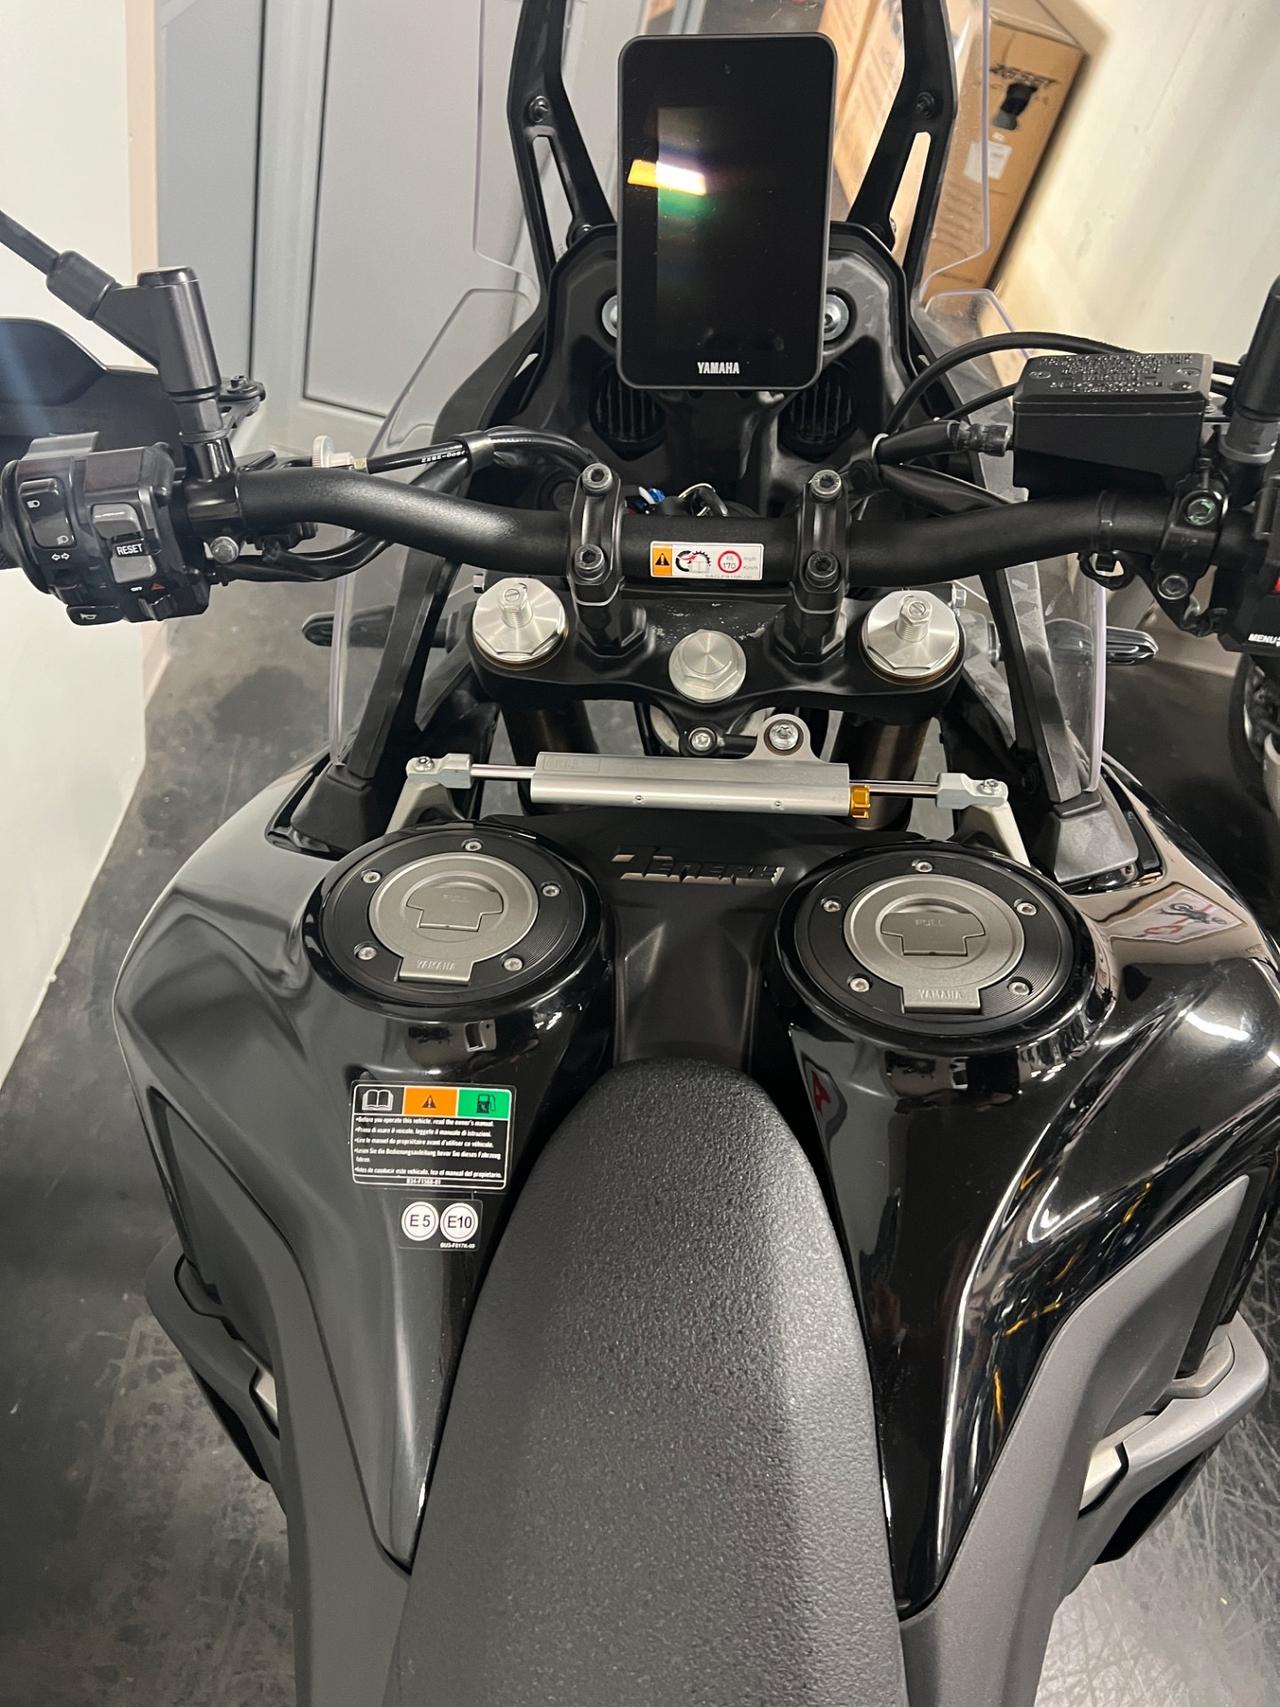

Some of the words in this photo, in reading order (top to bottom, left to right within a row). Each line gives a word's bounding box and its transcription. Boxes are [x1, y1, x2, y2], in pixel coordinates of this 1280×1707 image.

[697, 361, 740, 374] YAMAHA
[116, 543, 143, 555] RESET
[723, 562, 737, 570] 170
[1248, 633, 1277, 644] MENU
[919, 989, 961, 999] YAMAHA
[447, 1215, 472, 1228] E10
